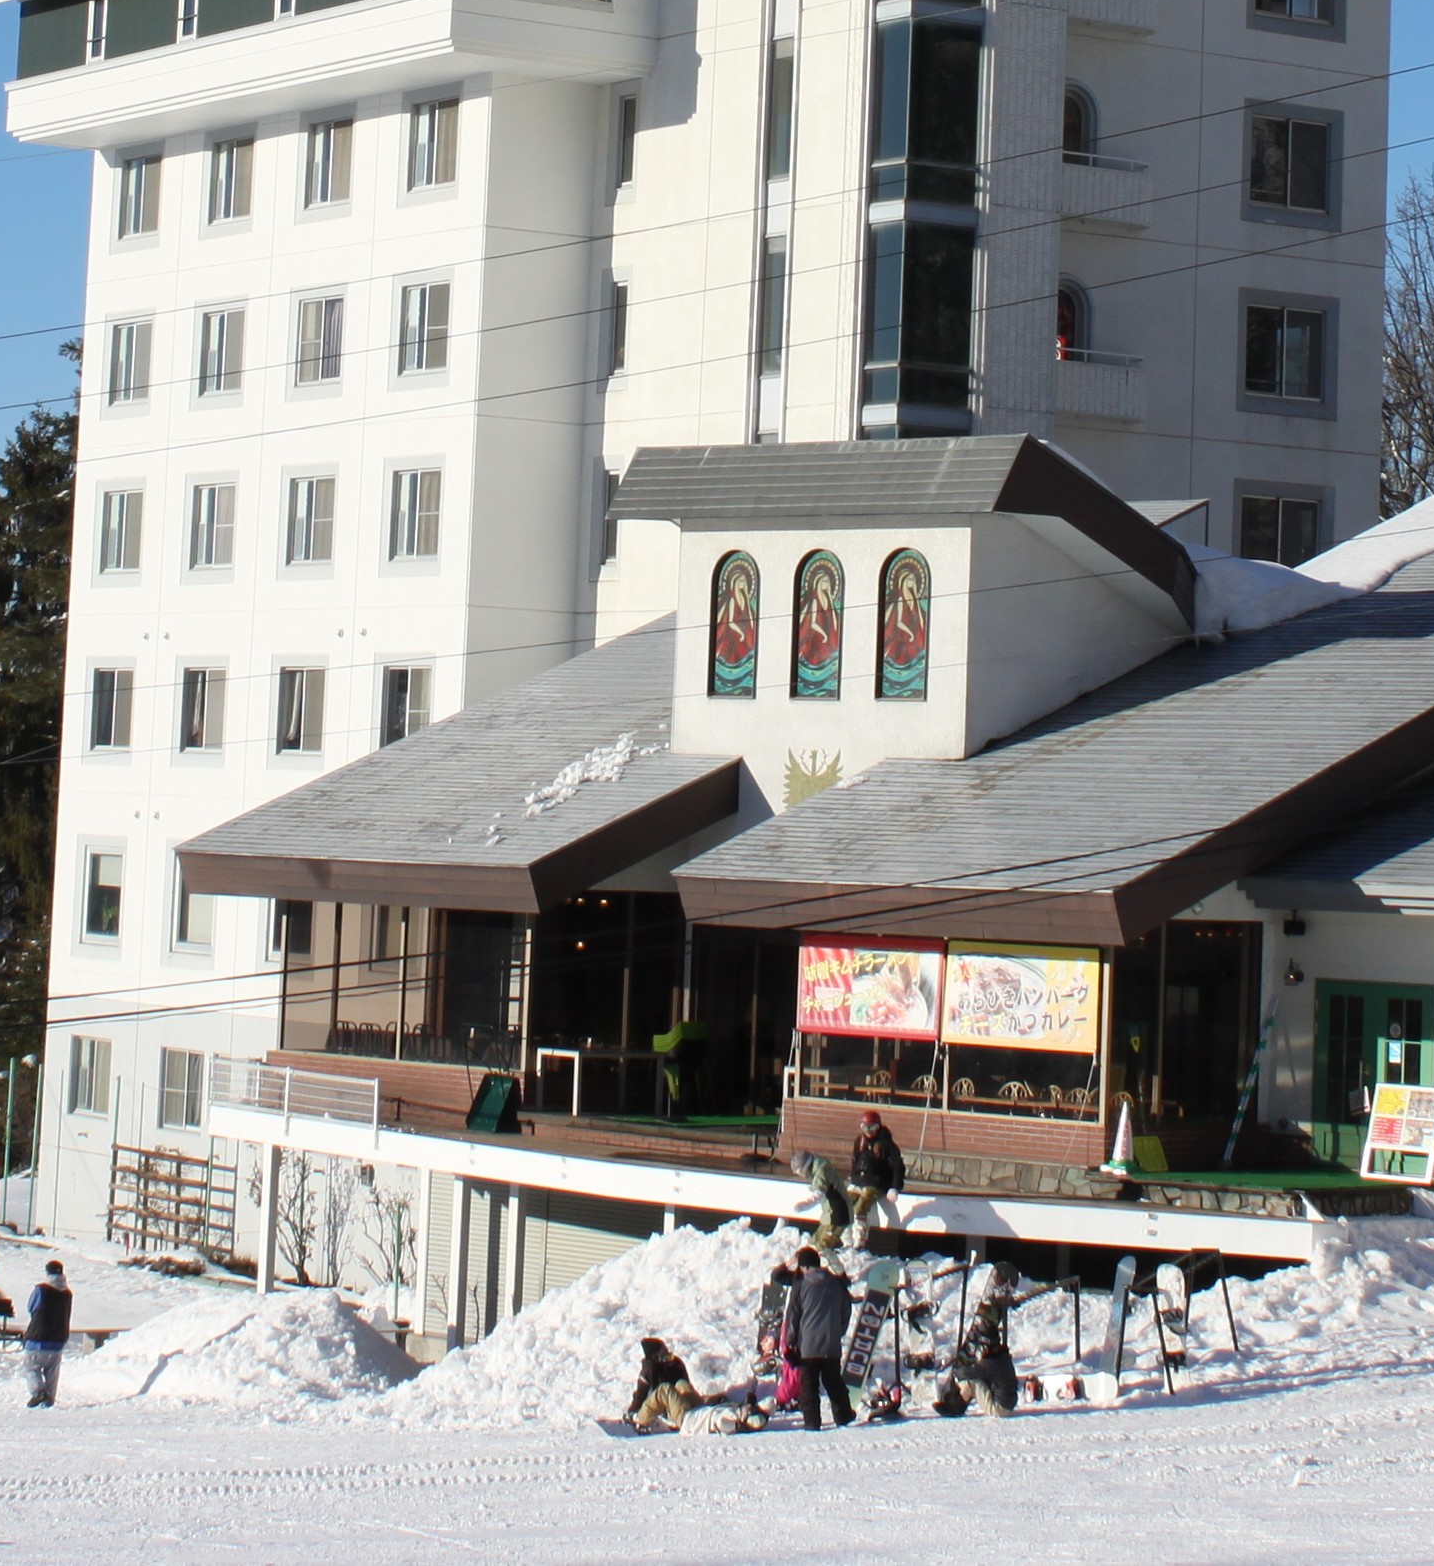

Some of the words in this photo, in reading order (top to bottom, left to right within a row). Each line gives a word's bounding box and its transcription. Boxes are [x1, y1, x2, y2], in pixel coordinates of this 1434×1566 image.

[958, 1011, 1088, 1034] チーズかつカレー
[847, 1302, 885, 1375] BURTON
